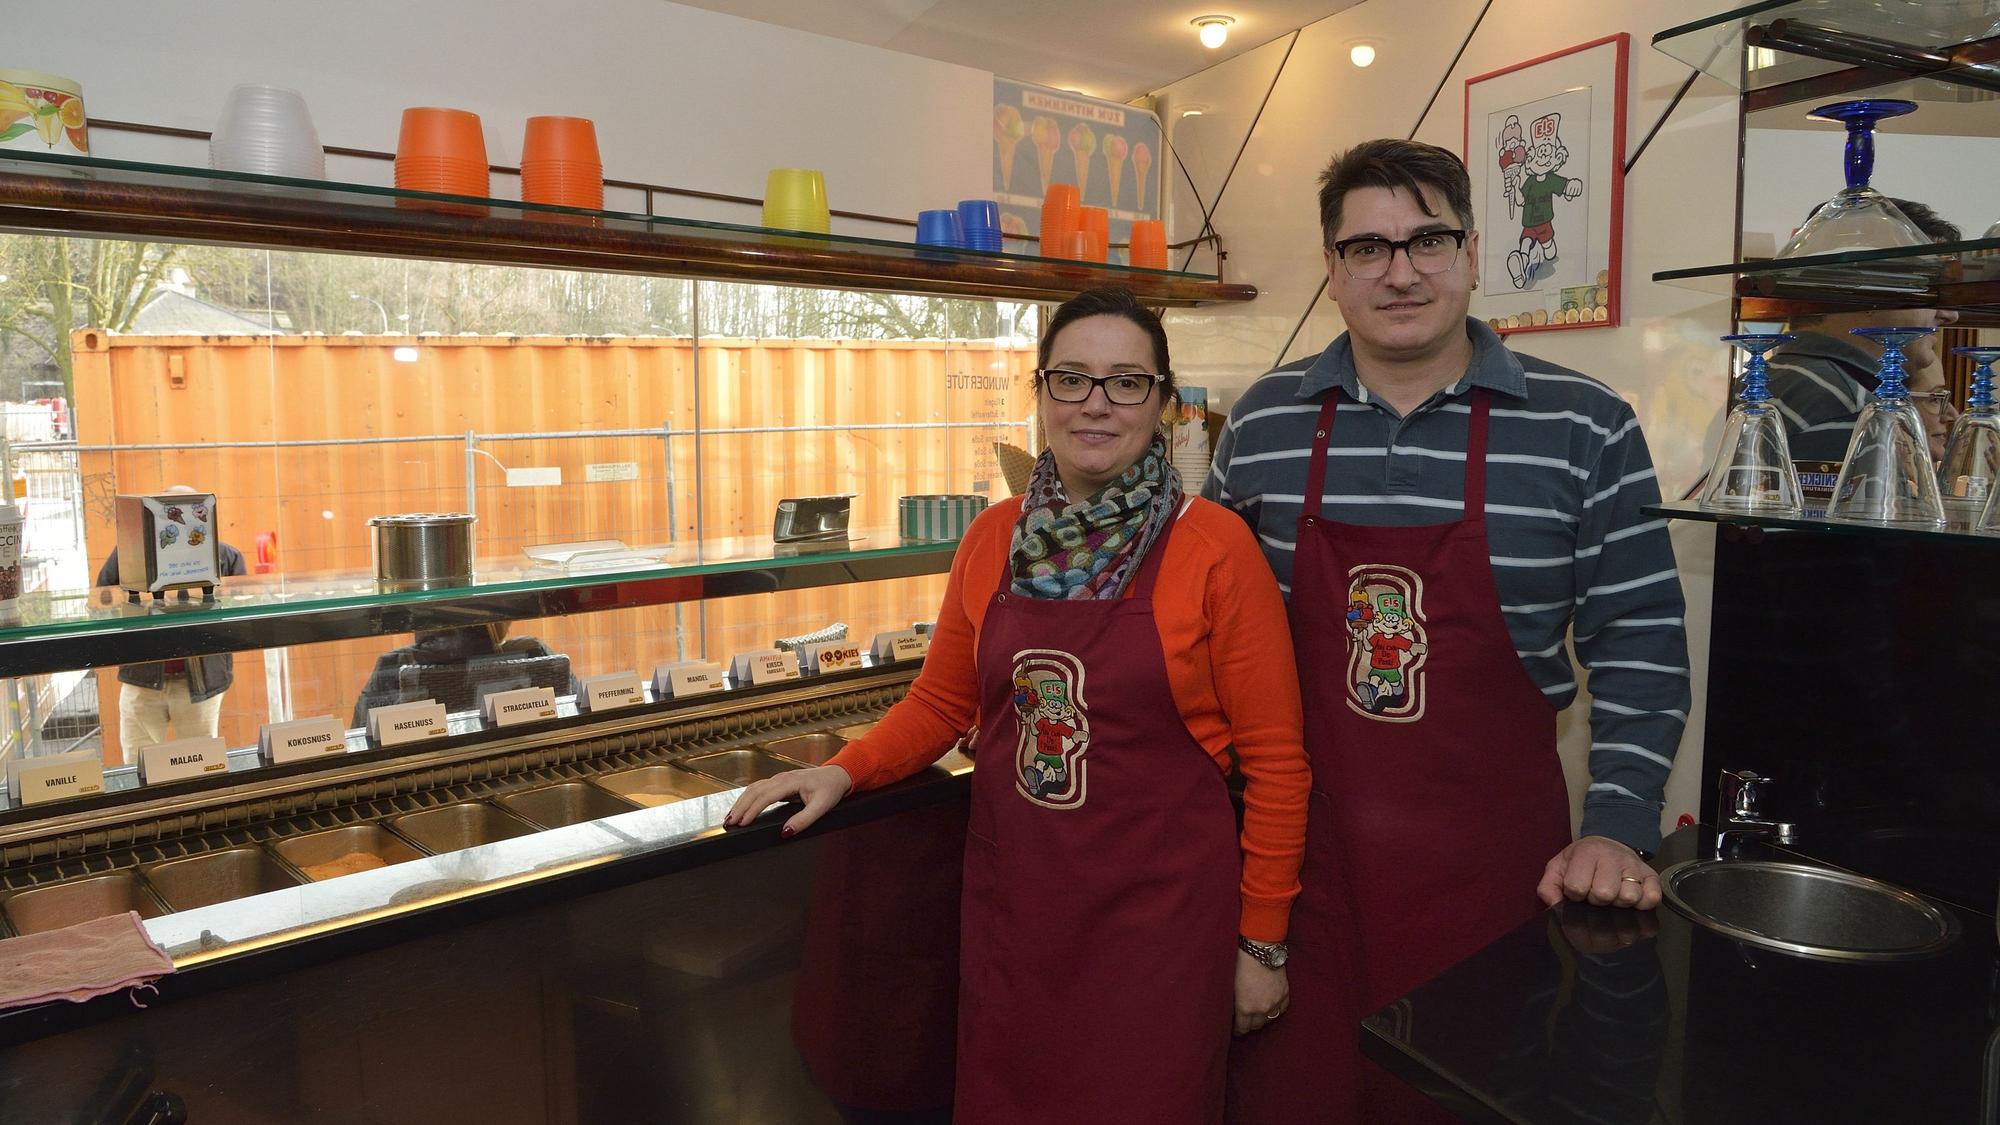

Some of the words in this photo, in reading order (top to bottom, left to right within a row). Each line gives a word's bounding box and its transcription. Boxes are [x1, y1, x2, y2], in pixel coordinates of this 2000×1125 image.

[1535, 119, 1554, 137] EIS
[820, 649, 859, 663] COOKIES
[687, 674, 708, 684] MANDEL
[598, 687, 634, 699] PFEFFERMINZ
[503, 700, 549, 713] STRACCIATELLA
[394, 718, 434, 731] HASELNUSS
[287, 733, 332, 748] KOKOSNUSS
[169, 753, 204, 767] MALAGA
[45, 774, 77, 788] VANILLE
